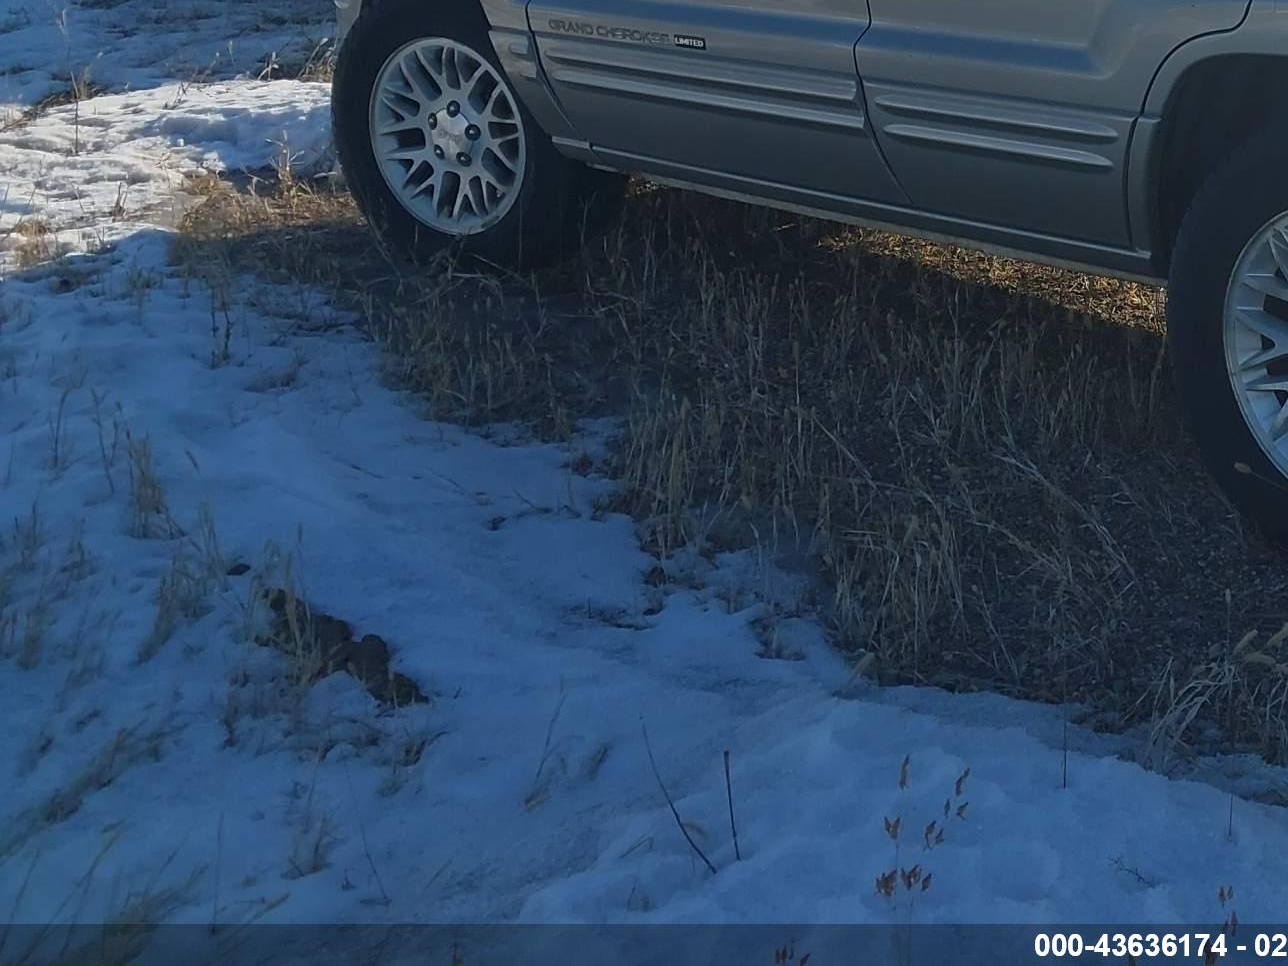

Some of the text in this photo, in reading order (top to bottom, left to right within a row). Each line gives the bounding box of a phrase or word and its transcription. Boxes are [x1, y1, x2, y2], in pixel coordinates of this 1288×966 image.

[548, 19, 705, 49] GRAND CHEROKEE LIMITED
